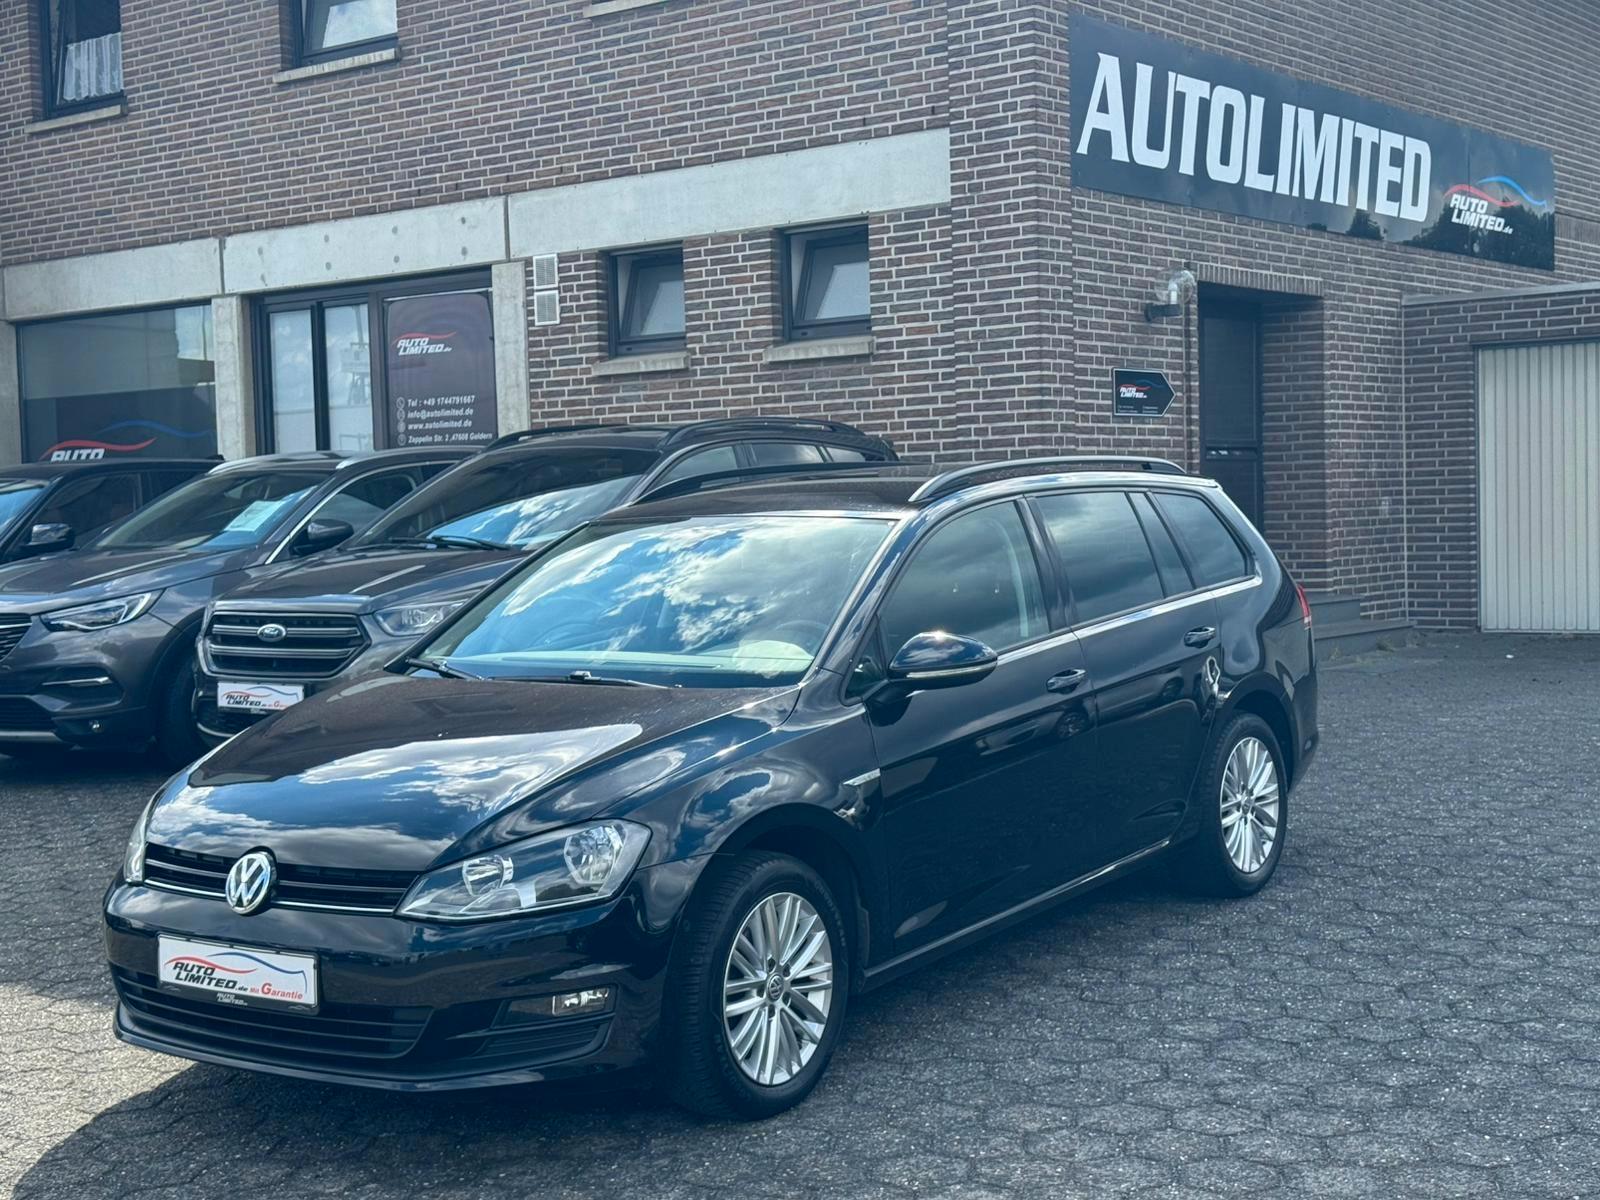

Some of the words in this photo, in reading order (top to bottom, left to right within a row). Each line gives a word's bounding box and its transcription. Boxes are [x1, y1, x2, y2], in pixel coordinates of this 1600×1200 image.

[1076, 52, 1432, 222] AUTOLIMITED
[1450, 193, 1489, 214] AUTO
[396, 337, 430, 348] AUTO
[407, 407, 474, 420] info@autolimited.de
[407, 418, 473, 430] www.autolimited.de
[469, 432, 493, 441] Geldern
[50, 448, 106, 462] AUTO
[173, 961, 217, 976] AUTO
[261, 982, 303, 1000] Garantie
